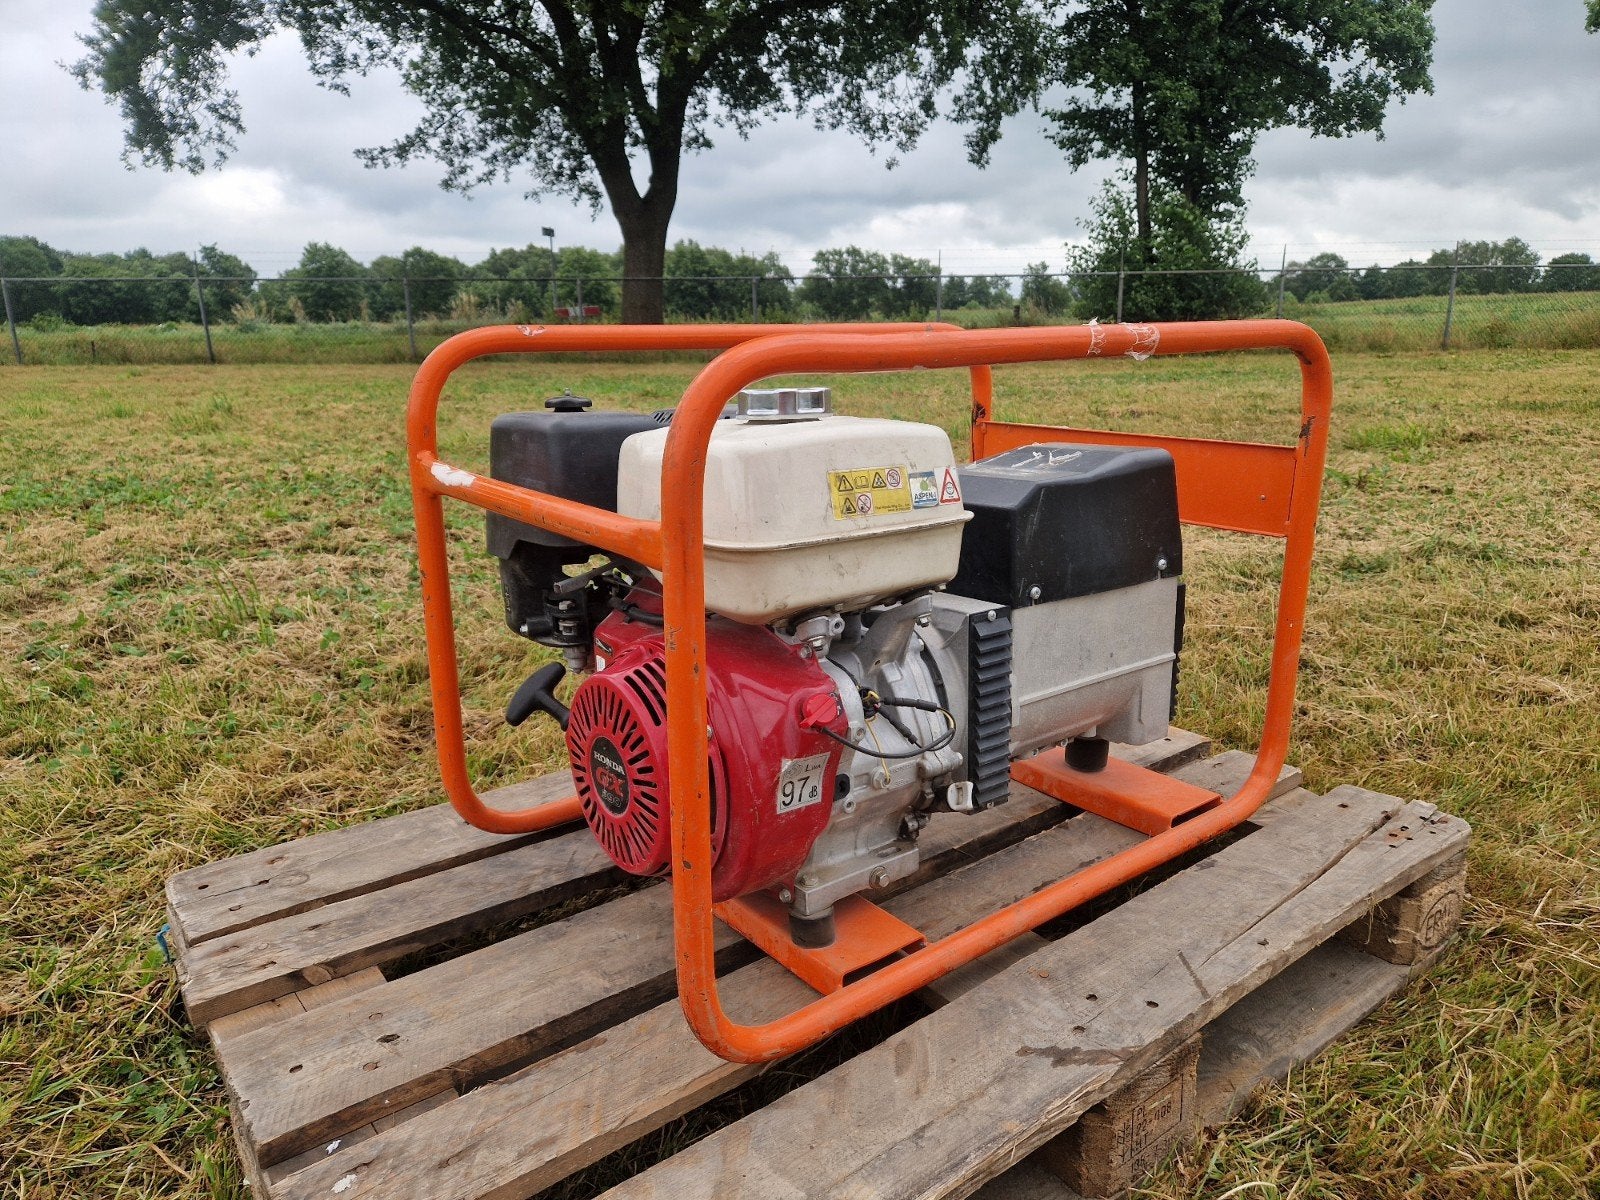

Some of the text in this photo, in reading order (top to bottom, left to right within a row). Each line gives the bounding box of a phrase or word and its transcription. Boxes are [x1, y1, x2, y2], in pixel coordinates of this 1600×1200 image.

[593, 751, 626, 776] HONDA
[596, 767, 625, 798] GX
[782, 775, 818, 807] 97 dB
